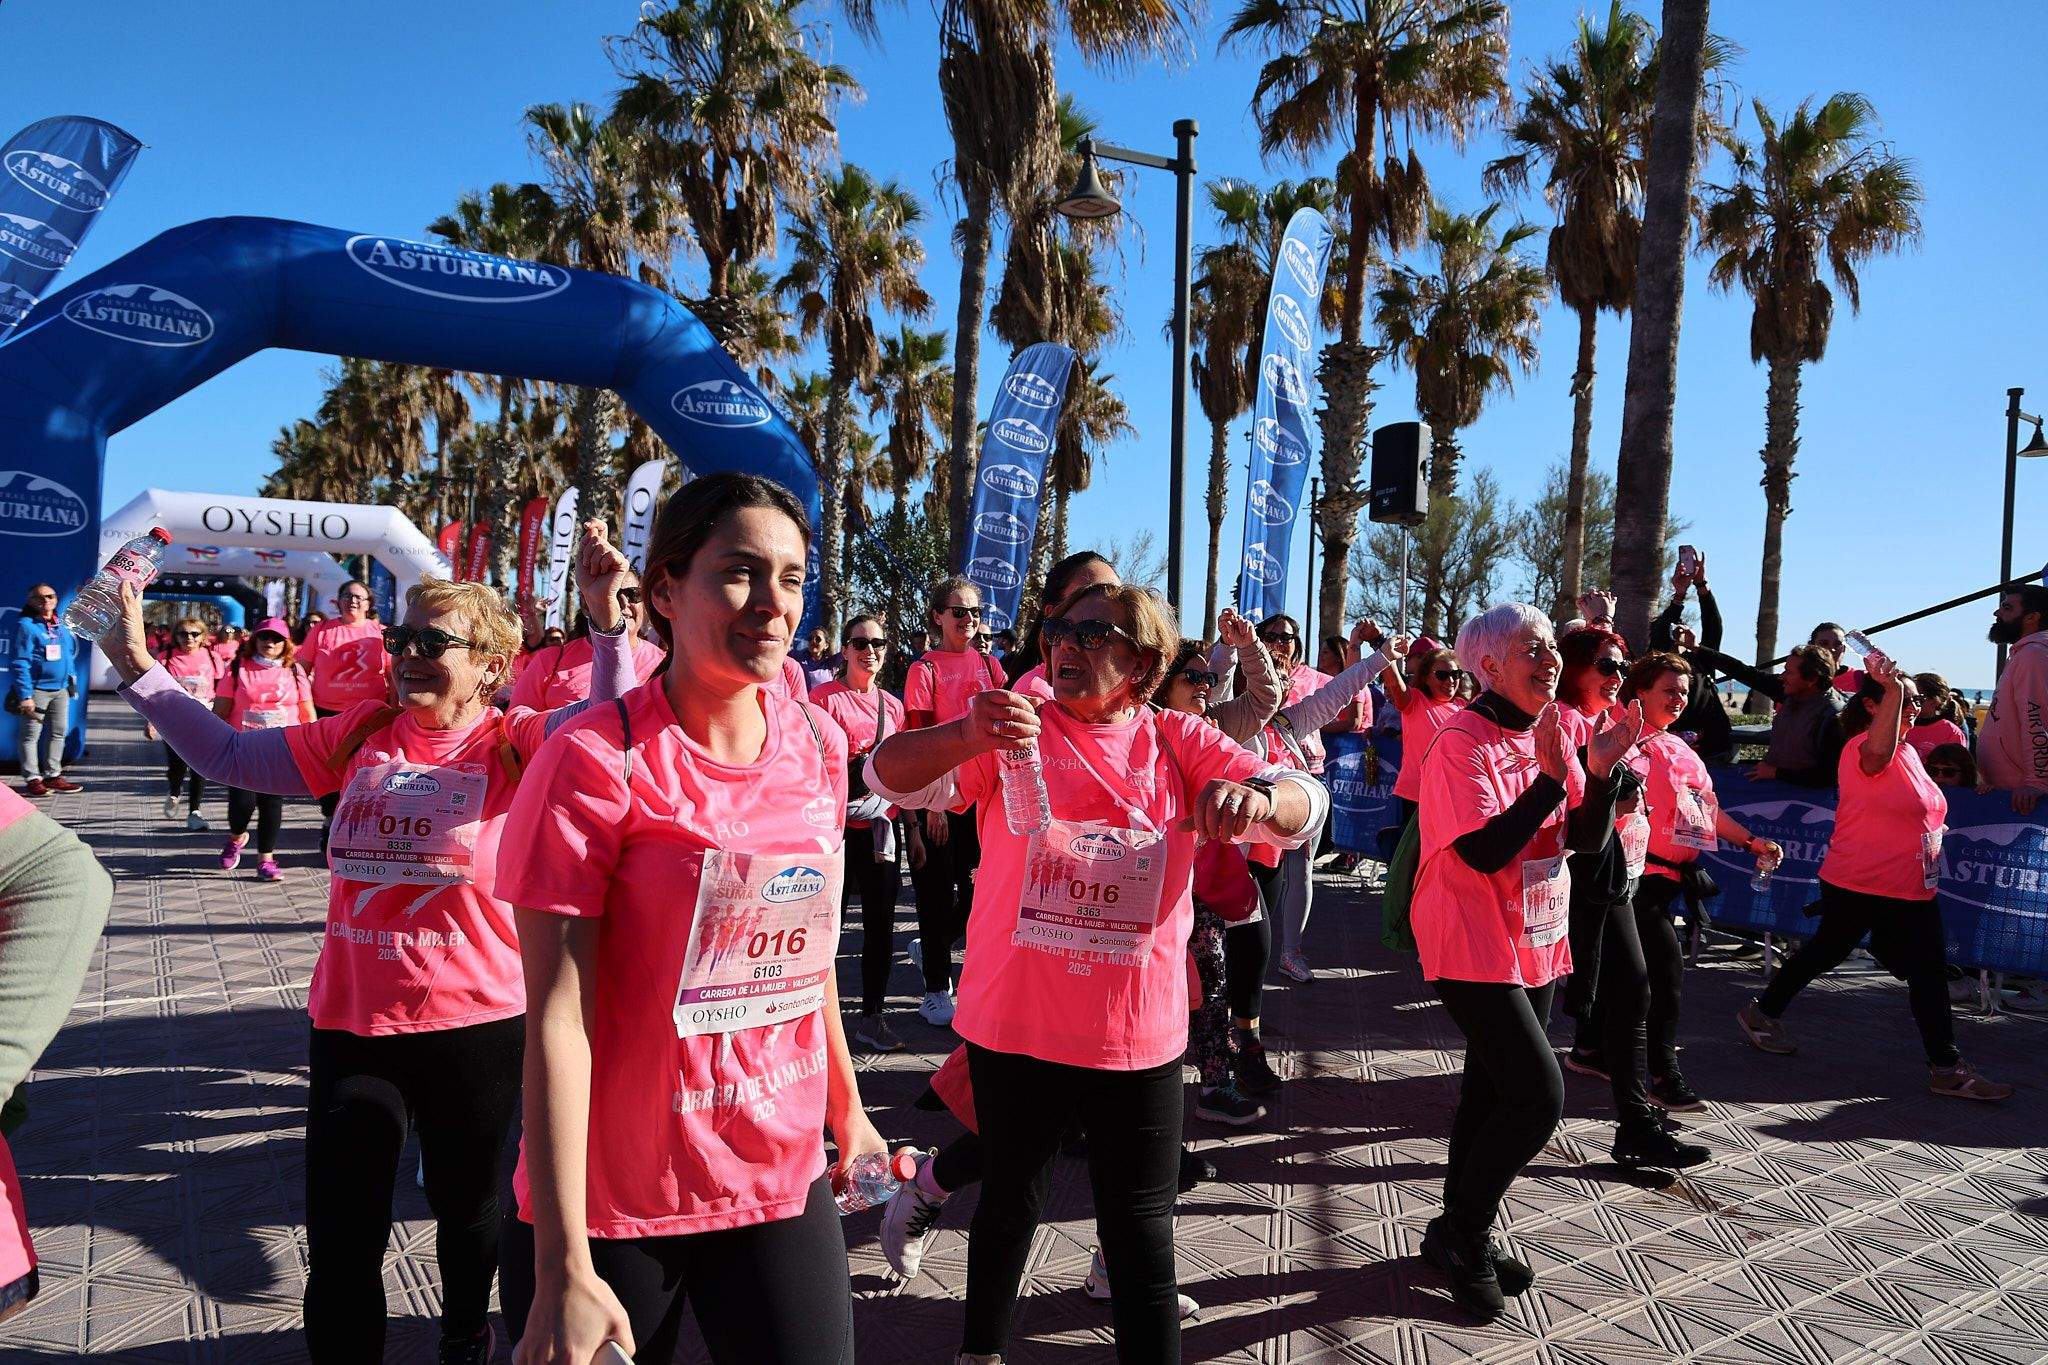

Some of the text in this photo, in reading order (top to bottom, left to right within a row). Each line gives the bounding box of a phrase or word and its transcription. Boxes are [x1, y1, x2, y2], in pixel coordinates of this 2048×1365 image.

[364, 240, 557, 287] ASTURIANA
[73, 299, 202, 338] ASTURIANA
[679, 394, 767, 418] ASTURIANA
[997, 426, 1045, 450] ASTURIANA
[985, 469, 1035, 494] ASTURIANA
[202, 504, 350, 541] OYSHO
[975, 518, 1026, 541] ASTURIANA
[967, 565, 1017, 584] ASTURIANA
[2027, 700, 2043, 729] AIR
[385, 778, 436, 792] ASTURIANA
[378, 815, 432, 837] 016
[387, 840, 412, 851] 8338
[1073, 840, 1121, 857] ASTURIANA
[345, 850, 374, 859] CARRERA
[396, 853, 418, 862] MUJER
[423, 855, 453, 864] VALENCIA
[344, 864, 386, 876] OYSHO
[413, 869, 456, 878] Santander
[1069, 880, 1120, 904] 016
[1076, 906, 1101, 917] 8363
[1035, 912, 1063, 924] CARRERA
[1065, 917, 1073, 925] DE
[1074, 918, 1083, 926] LA
[1084, 919, 1105, 929] MUJER
[1110, 922, 1138, 932] VALENCIA
[378, 930, 394, 946] DE
[397, 931, 415, 947] LA
[418, 930, 466, 949] MUJER
[1030, 925, 1074, 941] OYSHO
[1099, 937, 1139, 948] Santander
[747, 927, 807, 959] 016
[378, 948, 402, 961] 2025
[1088, 951, 1105, 964] LA
[1107, 952, 1150, 968] MUJER
[753, 964, 783, 979] 6103
[1067, 962, 1093, 977] 2025
[700, 987, 736, 1000] CARRERA
[738, 986, 749, 995] DE
[750, 984, 760, 994] LA
[761, 981, 787, 993] MUJER
[793, 975, 820, 988] VALENCIA
[778, 993, 817, 1012] Santander
[692, 1005, 747, 1024] OYSHO
[672, 1082, 747, 1115] CARRERA
[747, 1075, 765, 1101] DE
[764, 1069, 784, 1094] LA
[753, 1098, 776, 1123] 2025
